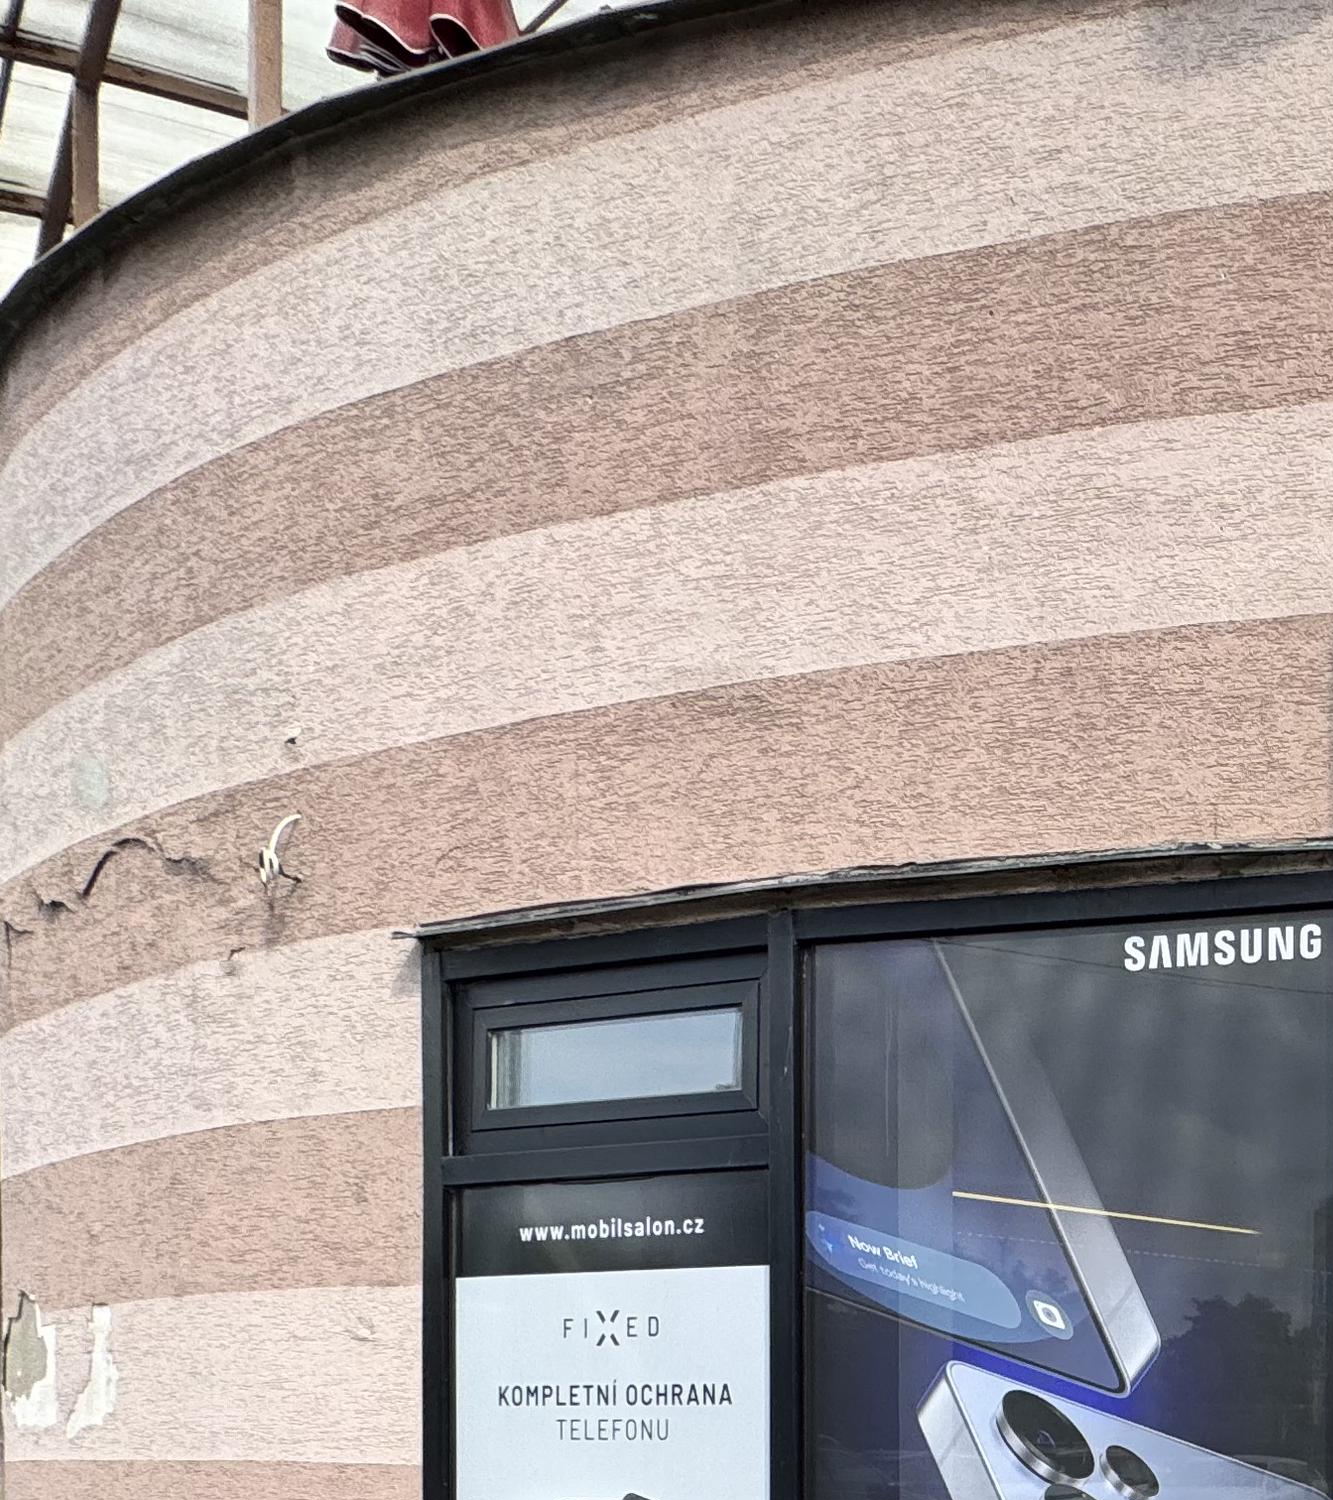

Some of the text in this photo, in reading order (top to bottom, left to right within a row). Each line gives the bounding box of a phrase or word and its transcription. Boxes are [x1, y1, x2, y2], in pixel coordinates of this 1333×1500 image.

[1123, 923, 1323, 972] SAMSUNG
[519, 1216, 705, 1243] www.mobilsalon.cz
[562, 1309, 661, 1347] FIXED
[497, 1377, 733, 1408] KOMPLETNÍ OCHRANA
[555, 1418, 670, 1441] TELEFONU
